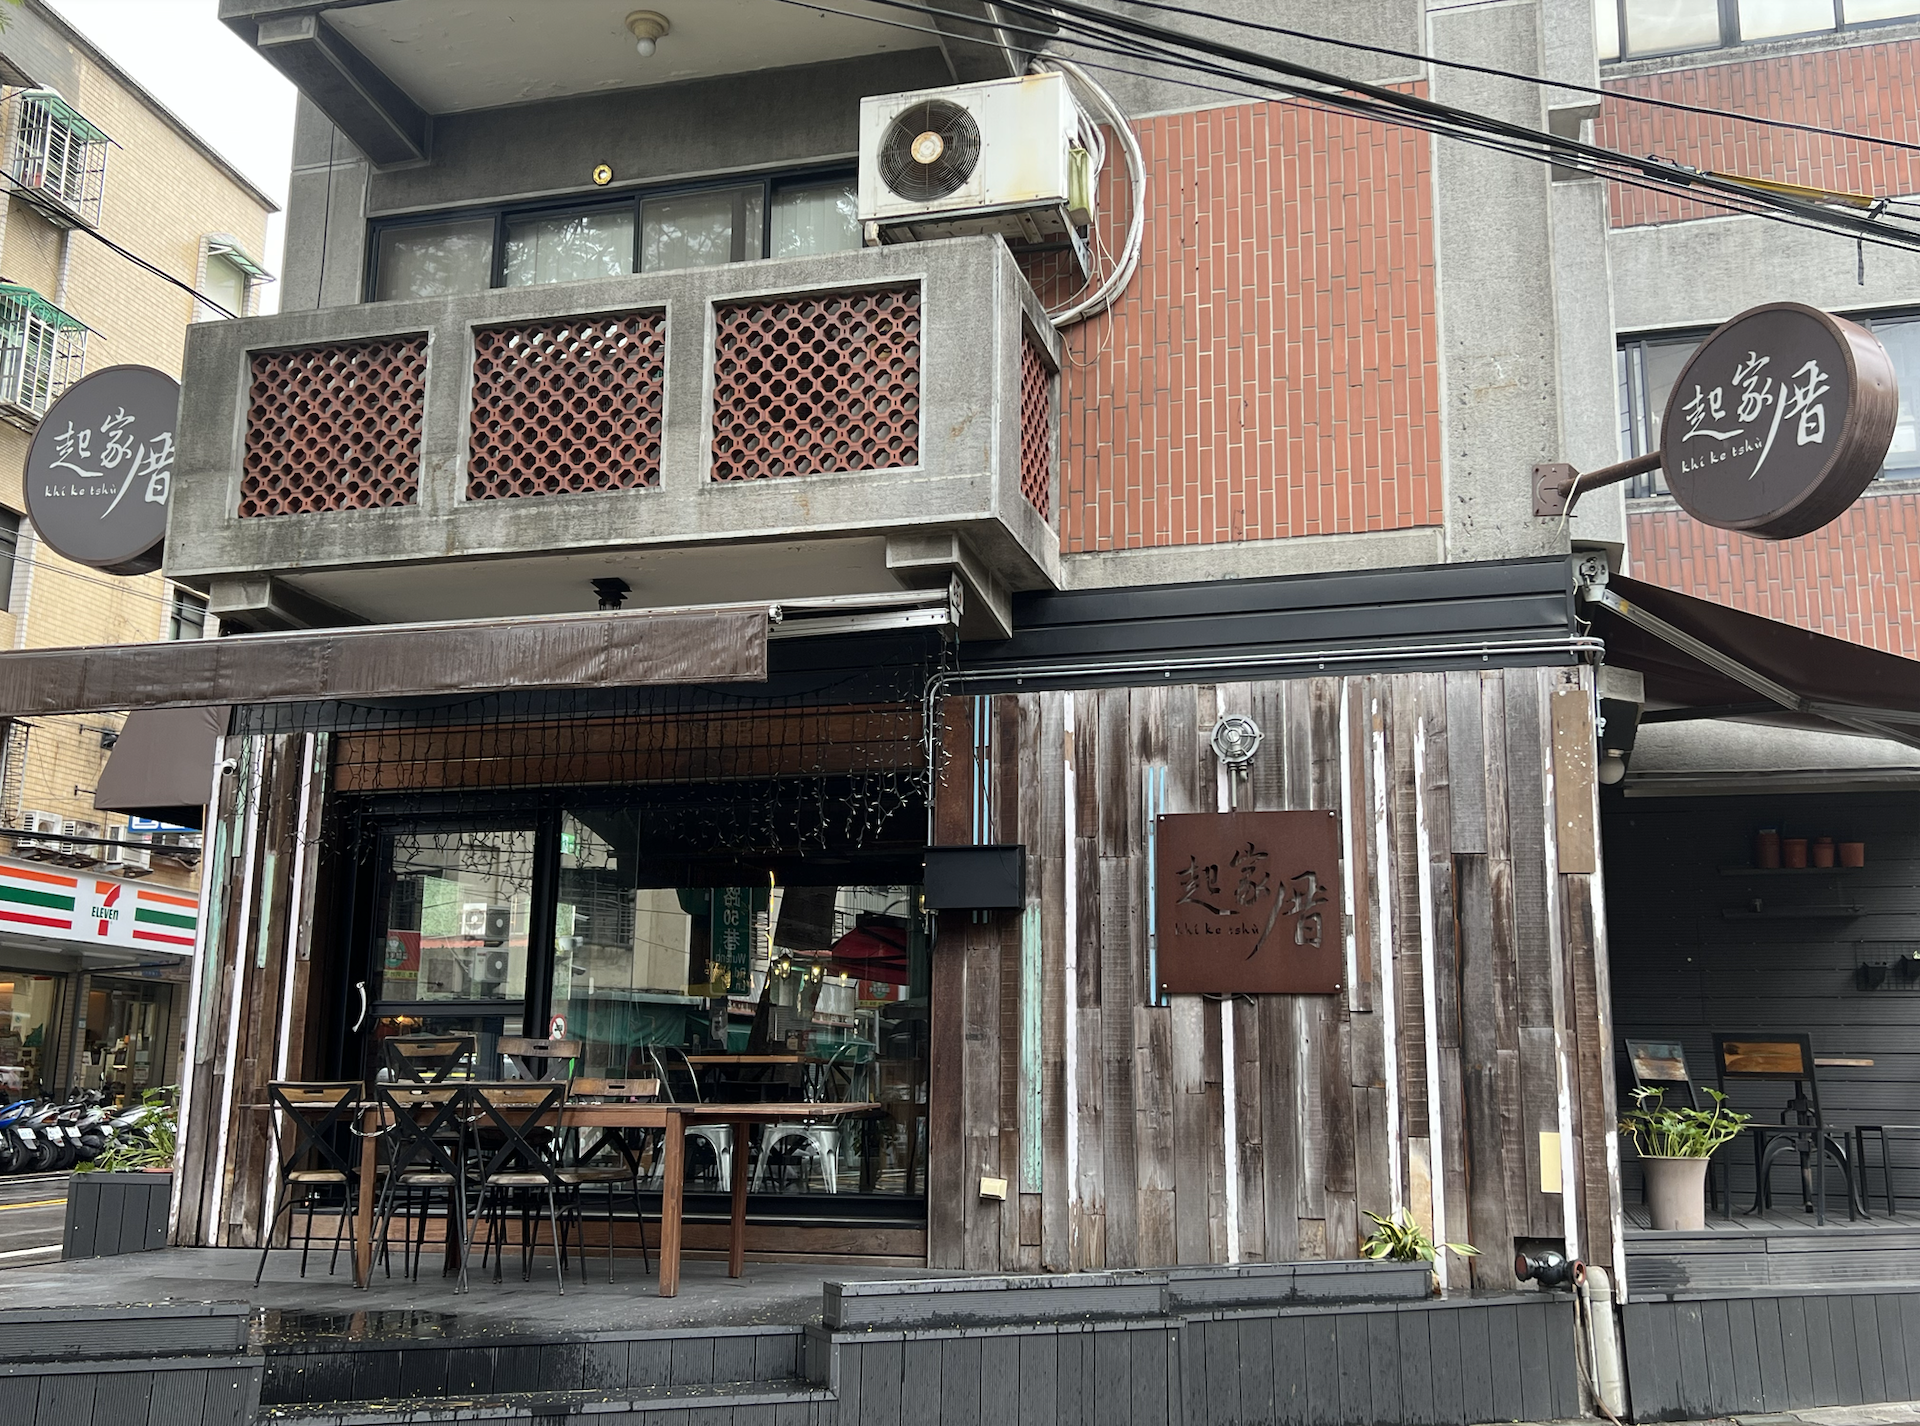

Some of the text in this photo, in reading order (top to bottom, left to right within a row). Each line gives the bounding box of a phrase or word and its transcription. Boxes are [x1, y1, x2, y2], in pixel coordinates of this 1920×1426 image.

[1681, 351, 1831, 481] 起家厝
[1710, 451, 1727, 465] ke
[70, 484, 85, 496] ke
[95, 880, 121, 936] 7
[1175, 841, 1329, 961] 起家厝
[1205, 922, 1222, 935] ke
